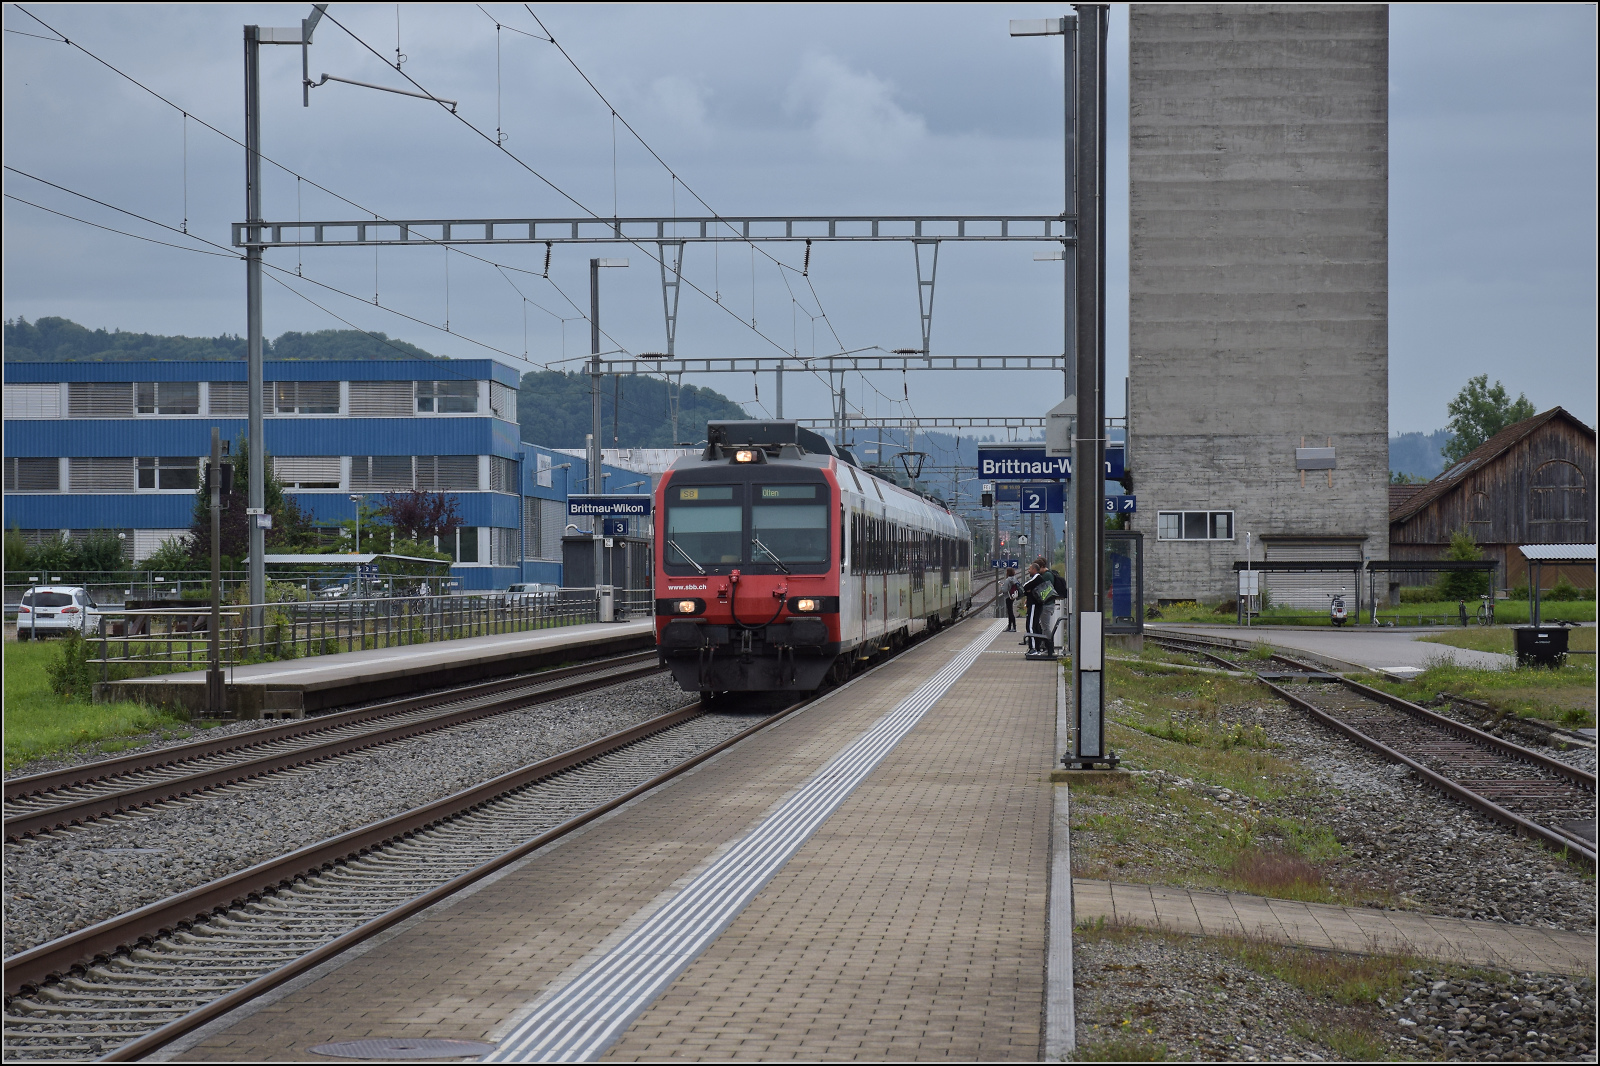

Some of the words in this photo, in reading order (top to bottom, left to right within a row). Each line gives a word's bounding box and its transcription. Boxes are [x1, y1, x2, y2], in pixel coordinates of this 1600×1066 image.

[983, 459, 1111, 474] Brittnau-Wn
[762, 489, 779, 497] Olten
[1029, 494, 1040, 509] 2
[1106, 501, 1114, 510] 3
[571, 503, 644, 513] Brittnau-Wikon
[616, 523, 624, 532] 3
